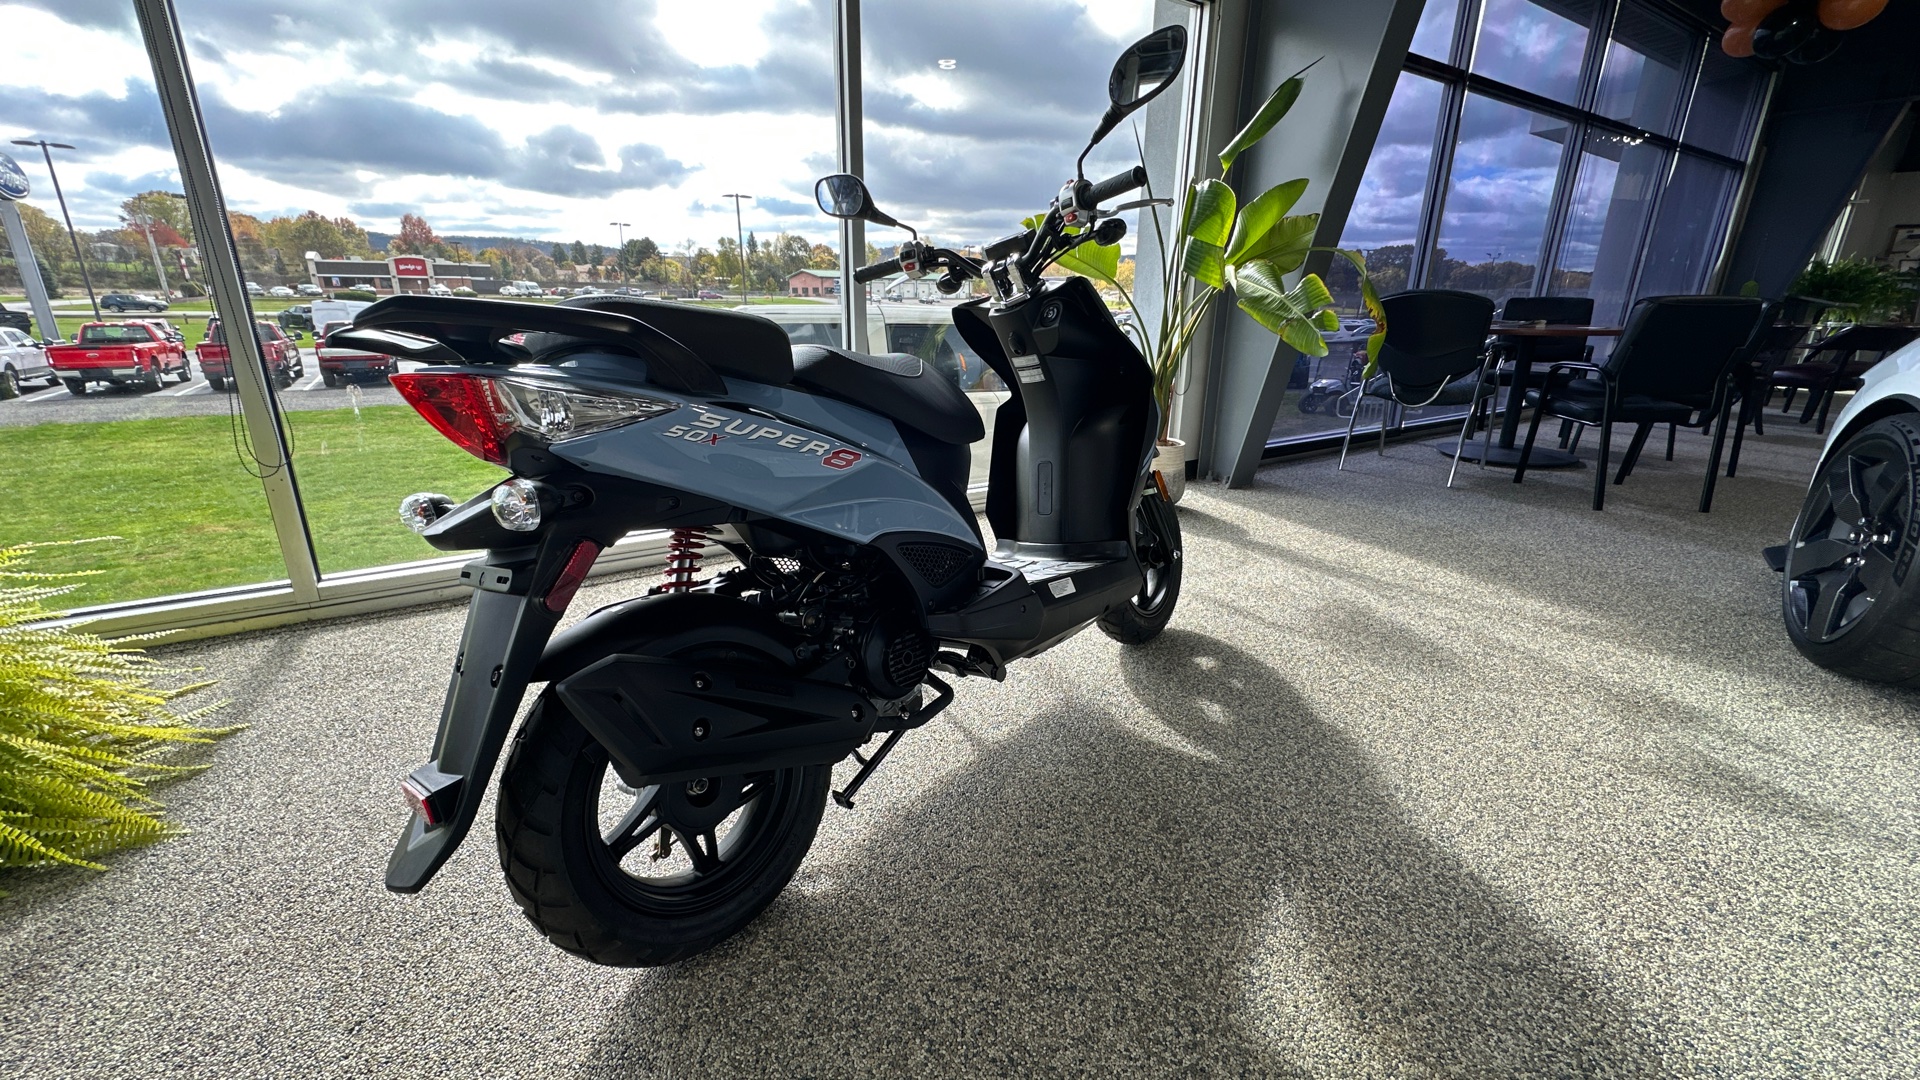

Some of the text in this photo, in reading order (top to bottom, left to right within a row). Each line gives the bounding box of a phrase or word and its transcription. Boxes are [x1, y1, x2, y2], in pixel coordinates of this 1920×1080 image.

[661, 424, 730, 446] 50X
[689, 412, 863, 471] SUPER 8
